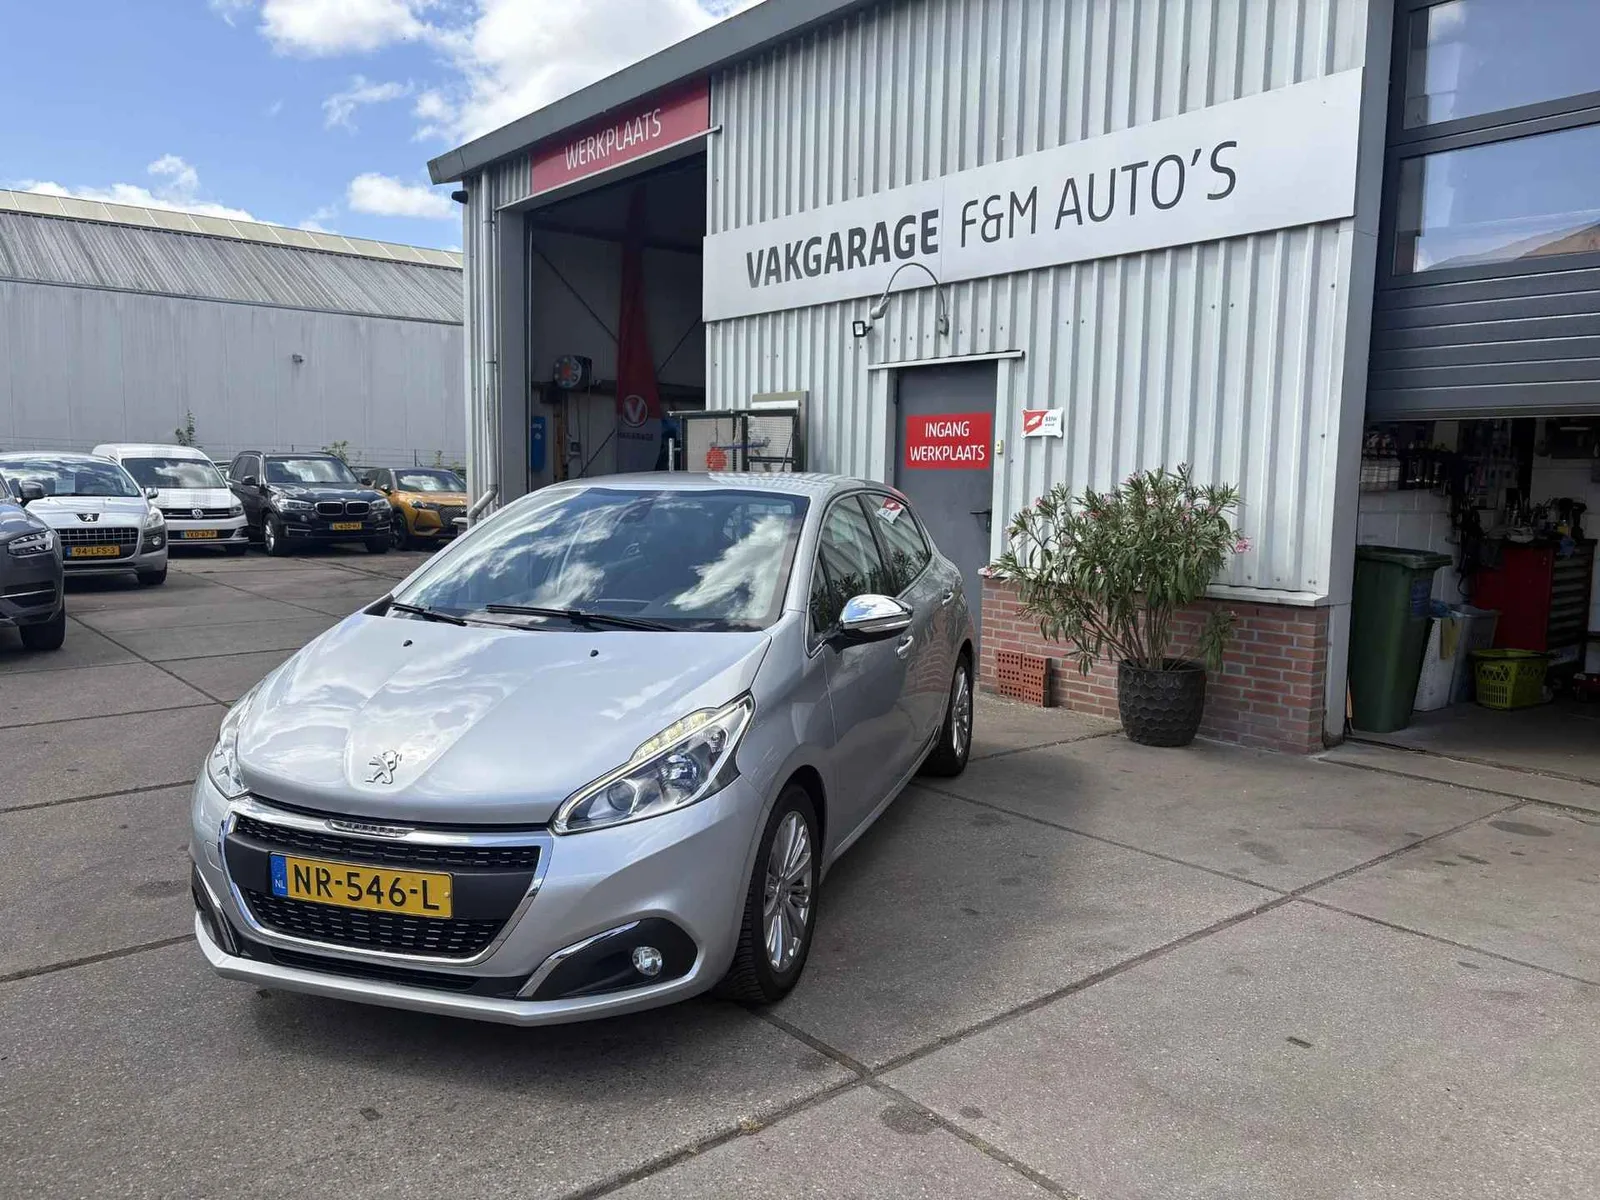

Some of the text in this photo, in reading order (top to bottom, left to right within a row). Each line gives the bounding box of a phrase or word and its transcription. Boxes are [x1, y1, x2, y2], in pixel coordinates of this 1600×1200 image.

[565, 108, 662, 169] WERKPLAATS
[746, 140, 1238, 288] VAKGARAGE F&M AUTO'S
[924, 420, 970, 437] INGANG
[910, 444, 985, 461] WERKPLAATS
[274, 879, 287, 889] NL
[293, 864, 440, 911] NR-546-L
